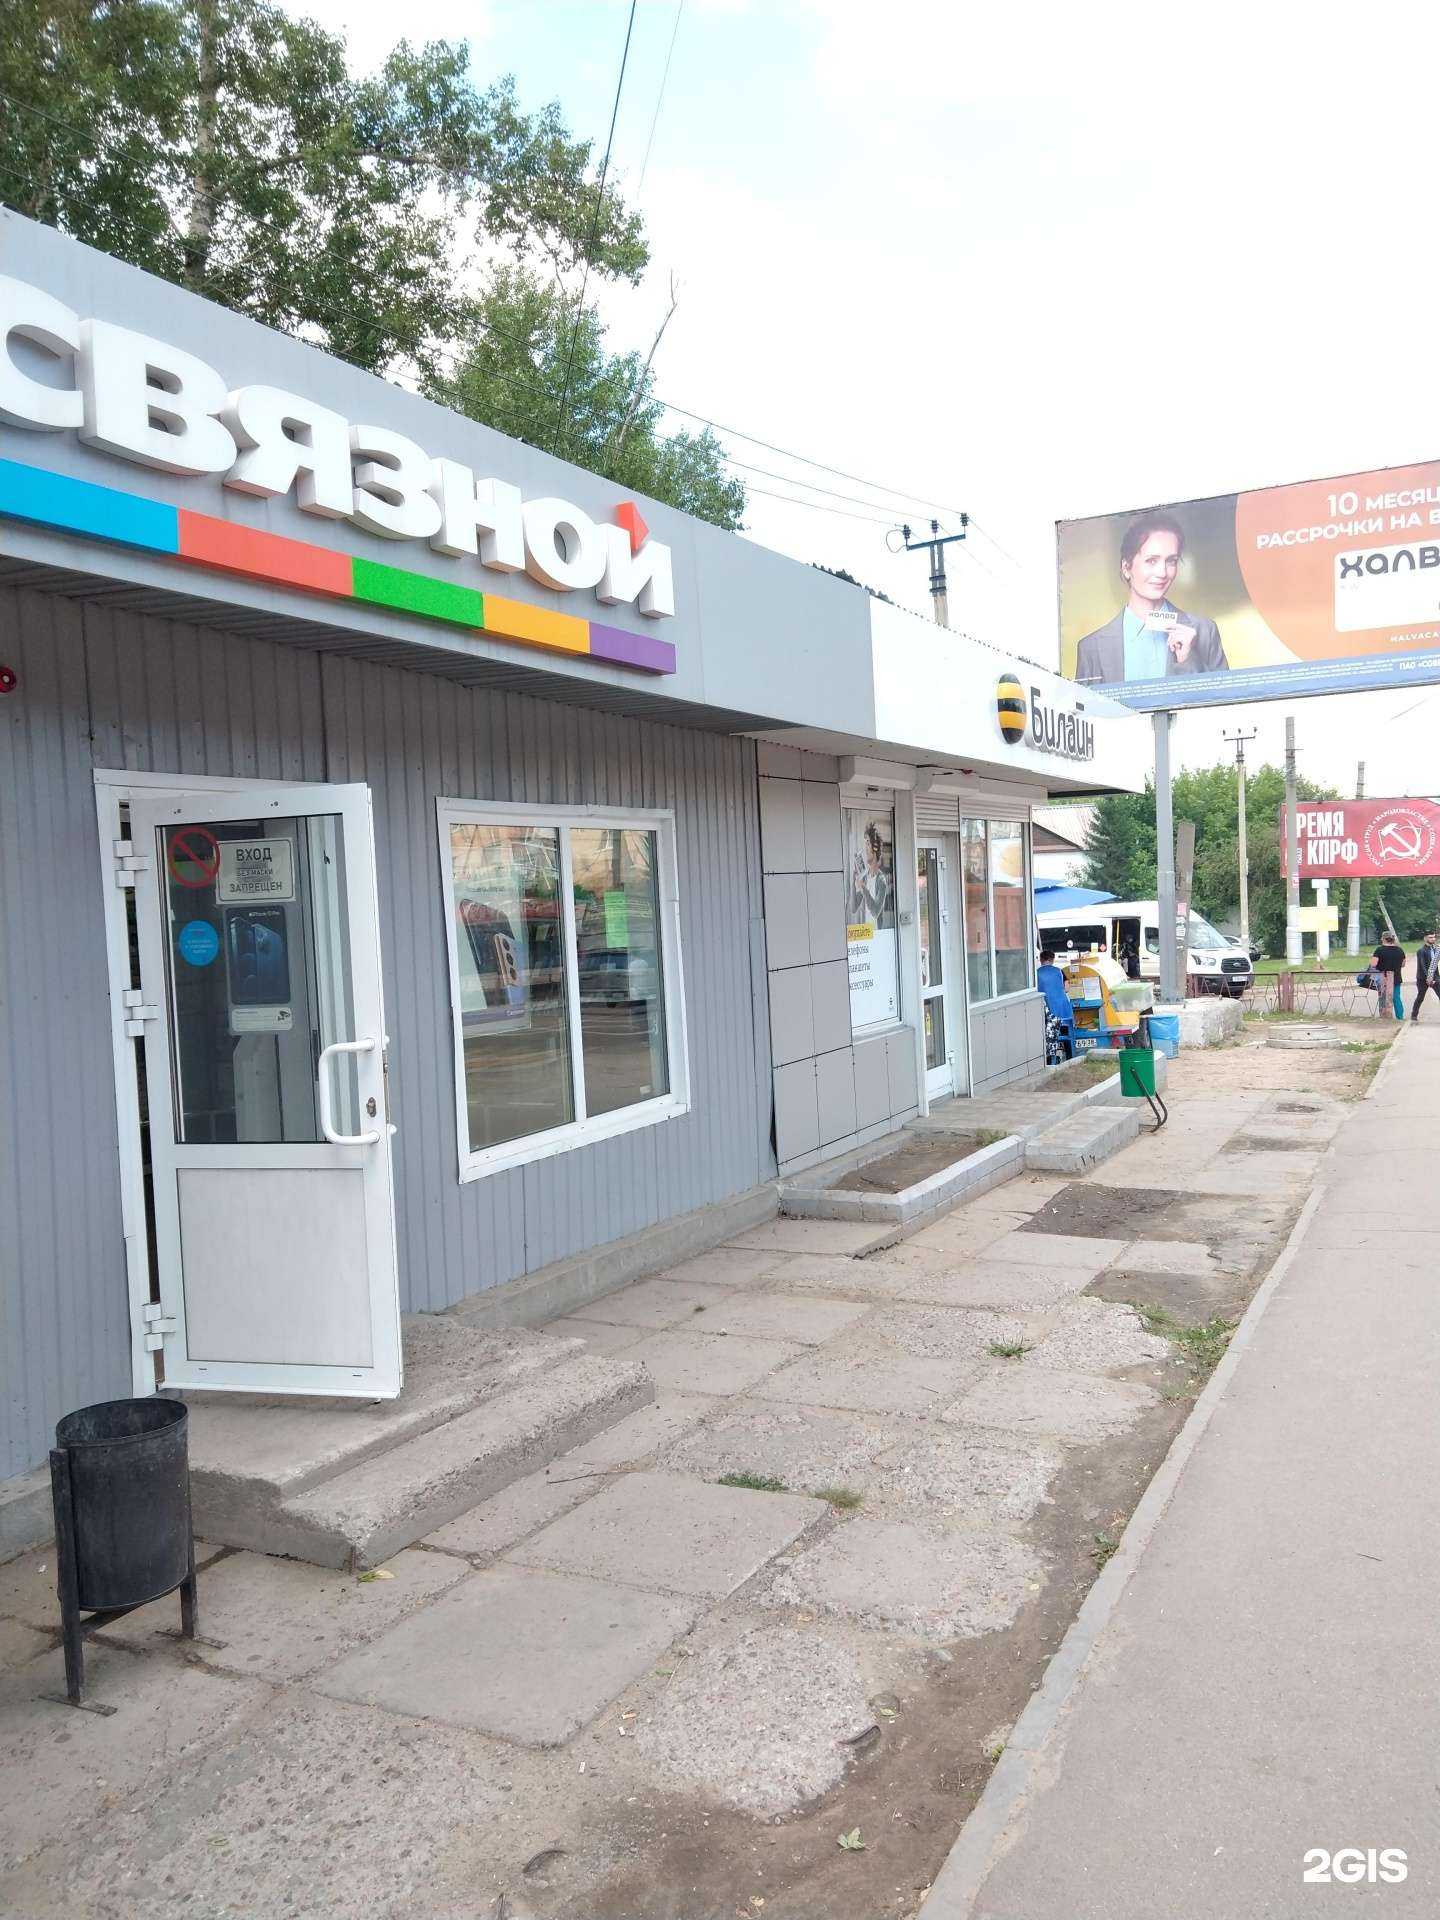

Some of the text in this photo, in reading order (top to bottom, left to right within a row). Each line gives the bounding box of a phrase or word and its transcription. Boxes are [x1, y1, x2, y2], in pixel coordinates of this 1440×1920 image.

[1328, 491, 1359, 517] 10
[1256, 517, 1384, 549] РАССРОЧКИ
[1390, 511, 1423, 530] НА
[1390, 630, 1440, 642] HALVACA
[1285, 811, 1345, 838] РЕМЯ
[236, 848, 273, 862] ВХОД
[1307, 838, 1359, 865] КПРФ
[229, 881, 283, 893] ЗАПРЕЩЕН
